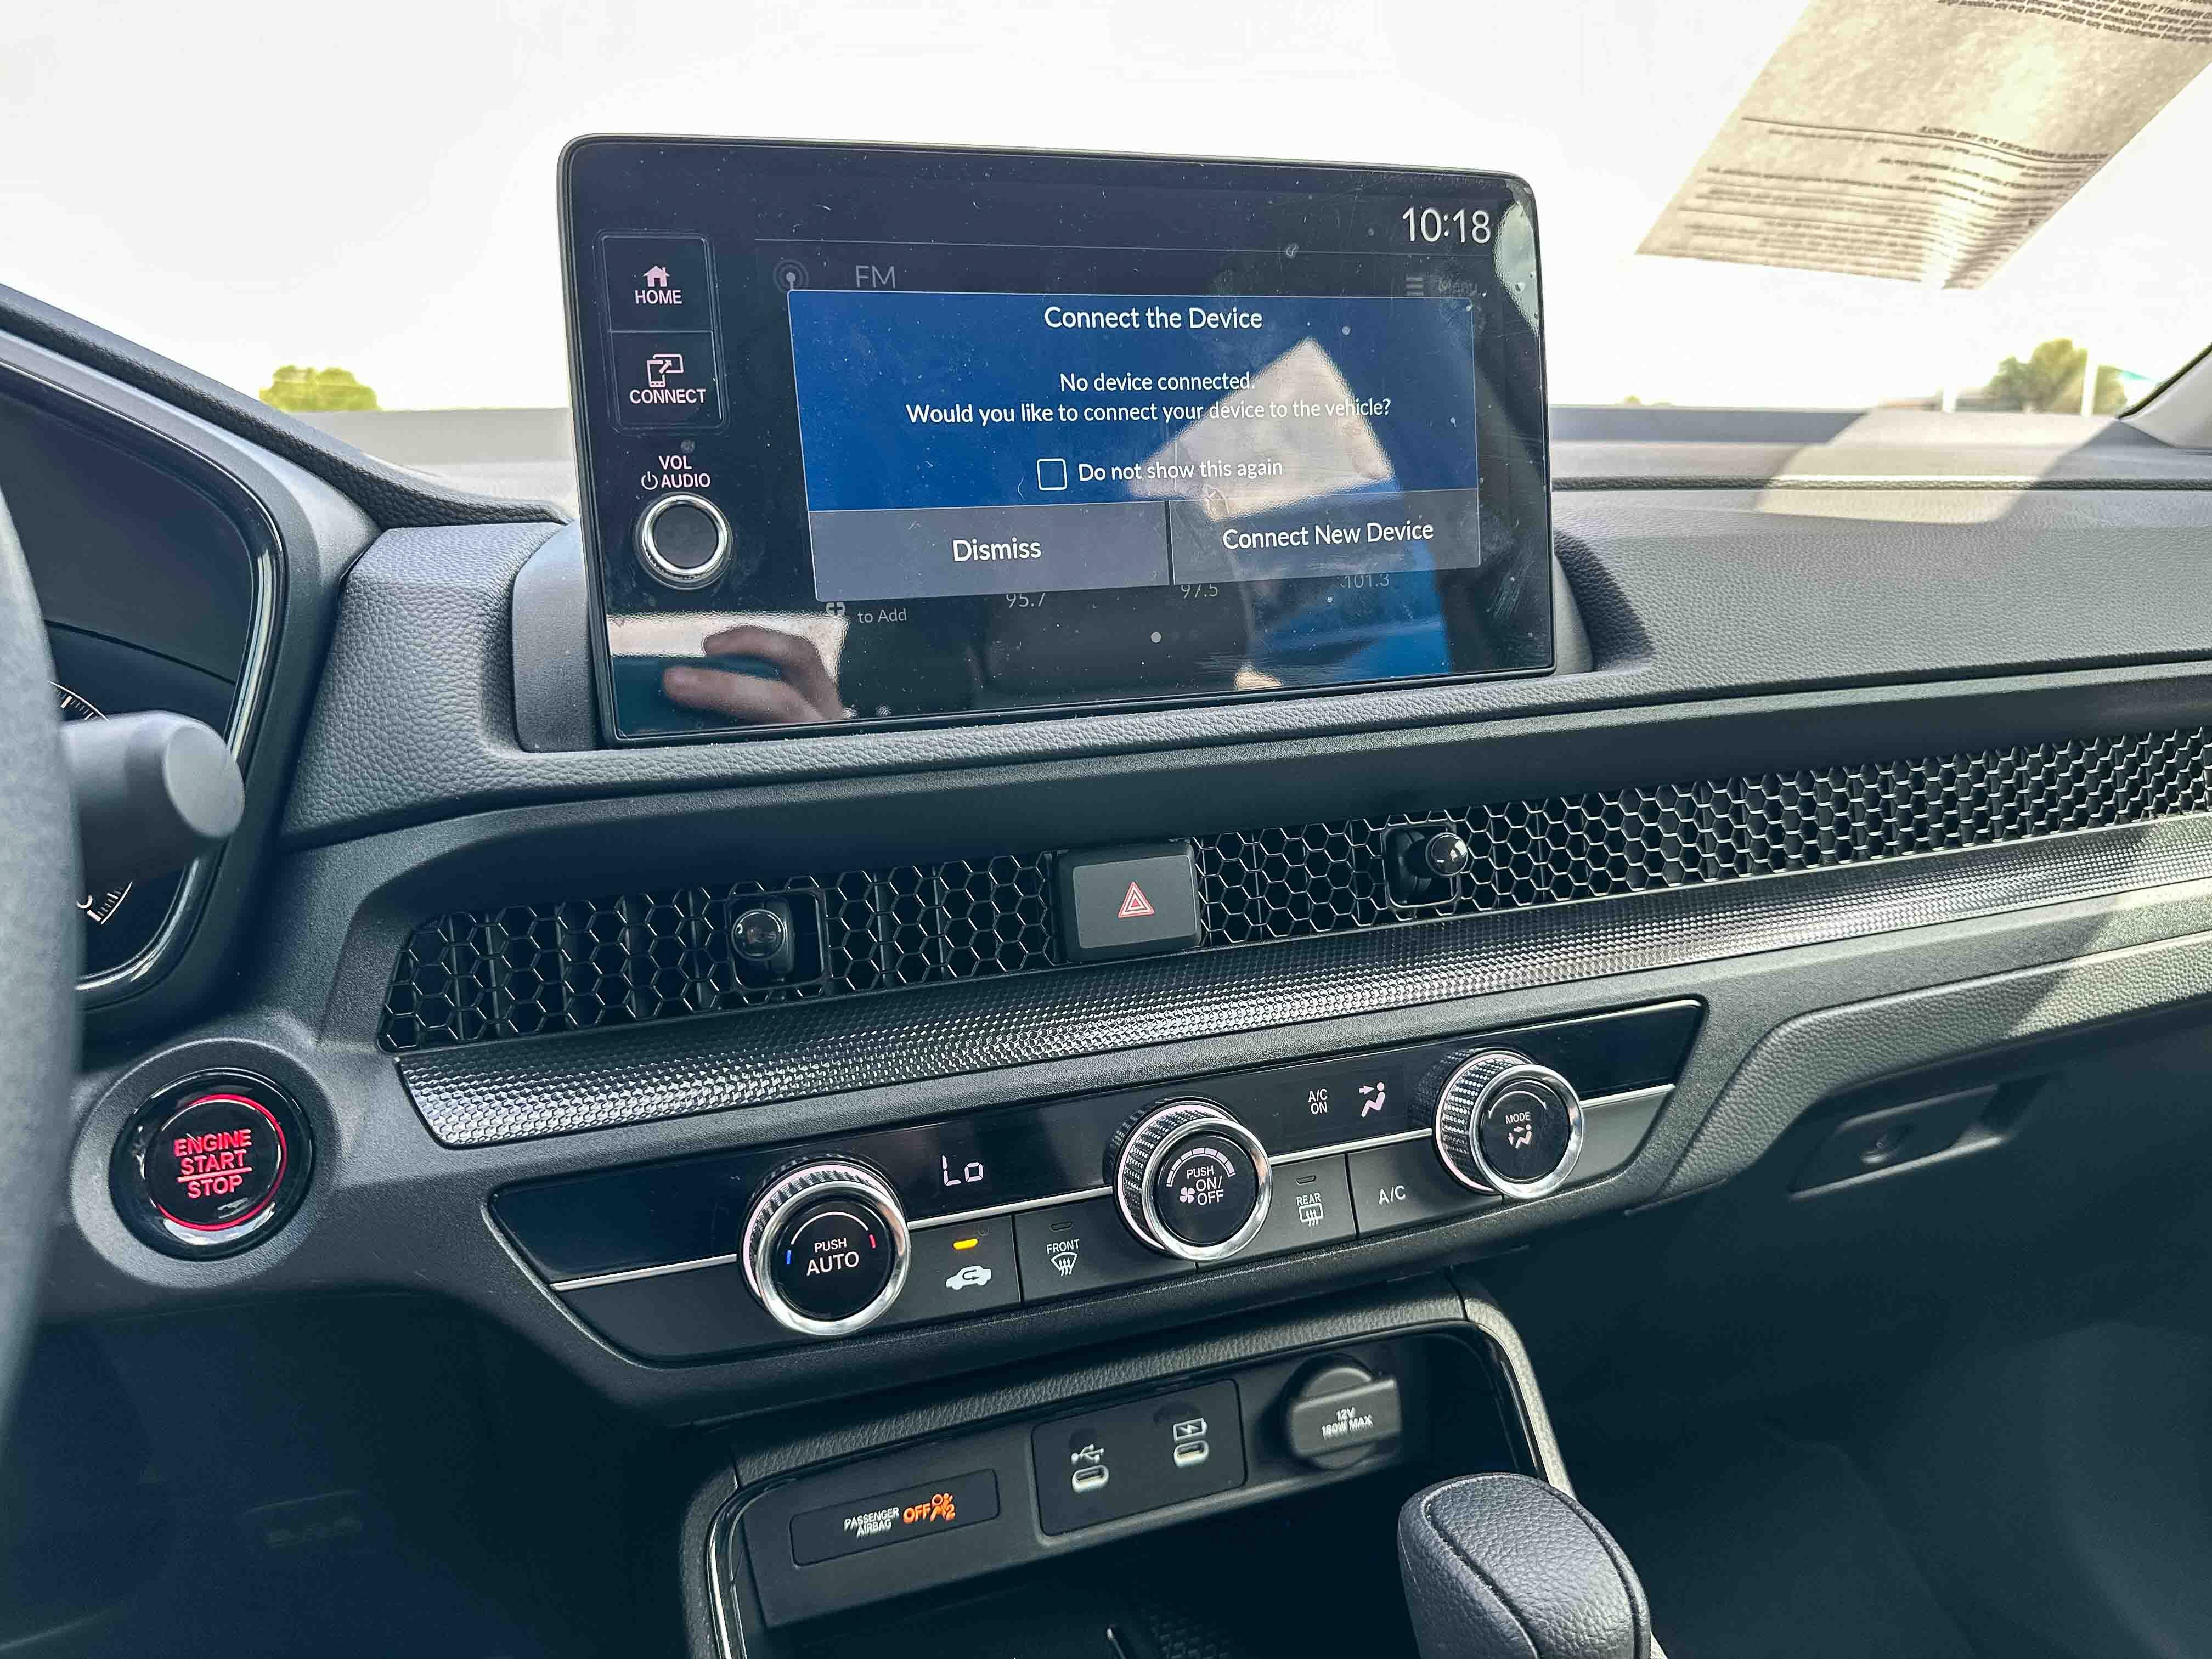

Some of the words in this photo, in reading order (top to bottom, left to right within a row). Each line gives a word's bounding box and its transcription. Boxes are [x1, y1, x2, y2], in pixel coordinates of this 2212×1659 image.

[1402, 206, 1491, 244] 10:18
[855, 265, 896, 289] FM
[635, 289, 682, 304] HOME
[1044, 306, 1140, 328] Connect
[1146, 306, 1182, 329] the
[1188, 307, 1262, 329] Device
[1060, 373, 1088, 391] No
[1093, 373, 1152, 391] device
[1158, 371, 1256, 391] connected.
[630, 389, 706, 404] CONNECT
[906, 404, 973, 423] Would
[979, 408, 1015, 426] you
[1021, 403, 1053, 422] like
[1058, 404, 1079, 421] to
[1084, 404, 1157, 421] connect
[1162, 405, 1204, 424] your
[1209, 400, 1265, 419] device
[1269, 402, 1288, 417] to
[1293, 399, 1321, 417] the
[1325, 398, 1391, 416] vehicle?
[658, 455, 692, 470] VOL
[1079, 464, 1107, 481] Do
[1111, 464, 1142, 480] not
[1147, 461, 1195, 478] show
[1200, 460, 1232, 477] this
[1237, 459, 1283, 479] again
[661, 473, 711, 488] AUDIO
[1223, 525, 1310, 549] Connect
[1315, 524, 1361, 545] New
[1367, 520, 1434, 543] Device
[952, 537, 1042, 562] Dismiss
[1344, 573, 1390, 589] 101.3
[857, 612, 873, 623] to
[878, 608, 907, 622] Add
[1308, 1088, 1328, 1103] A/C
[1311, 1101, 1328, 1115] ON
[1505, 1111, 1531, 1124] MODE
[174, 1128, 252, 1157] ENGINE
[180, 1149, 247, 1176] START
[942, 1155, 984, 1186] Lo
[1186, 1165, 1214, 1180] PUSH
[188, 1175, 243, 1199] STOP
[1195, 1175, 1223, 1192] ON/
[1197, 1189, 1224, 1206] OFF
[1296, 1192, 1321, 1206] REAR
[1379, 1185, 1406, 1205] A/C
[814, 1237, 847, 1254] PUSH
[1046, 1238, 1080, 1255] FRONT
[806, 1251, 860, 1277] AUTO
[1336, 1407, 1356, 1422] 12V
[1348, 1414, 1374, 1431] MAX
[843, 1506, 900, 1532] PASSENGER
[903, 1502, 932, 1525] OFF
[856, 1517, 892, 1541] AIRBAG
